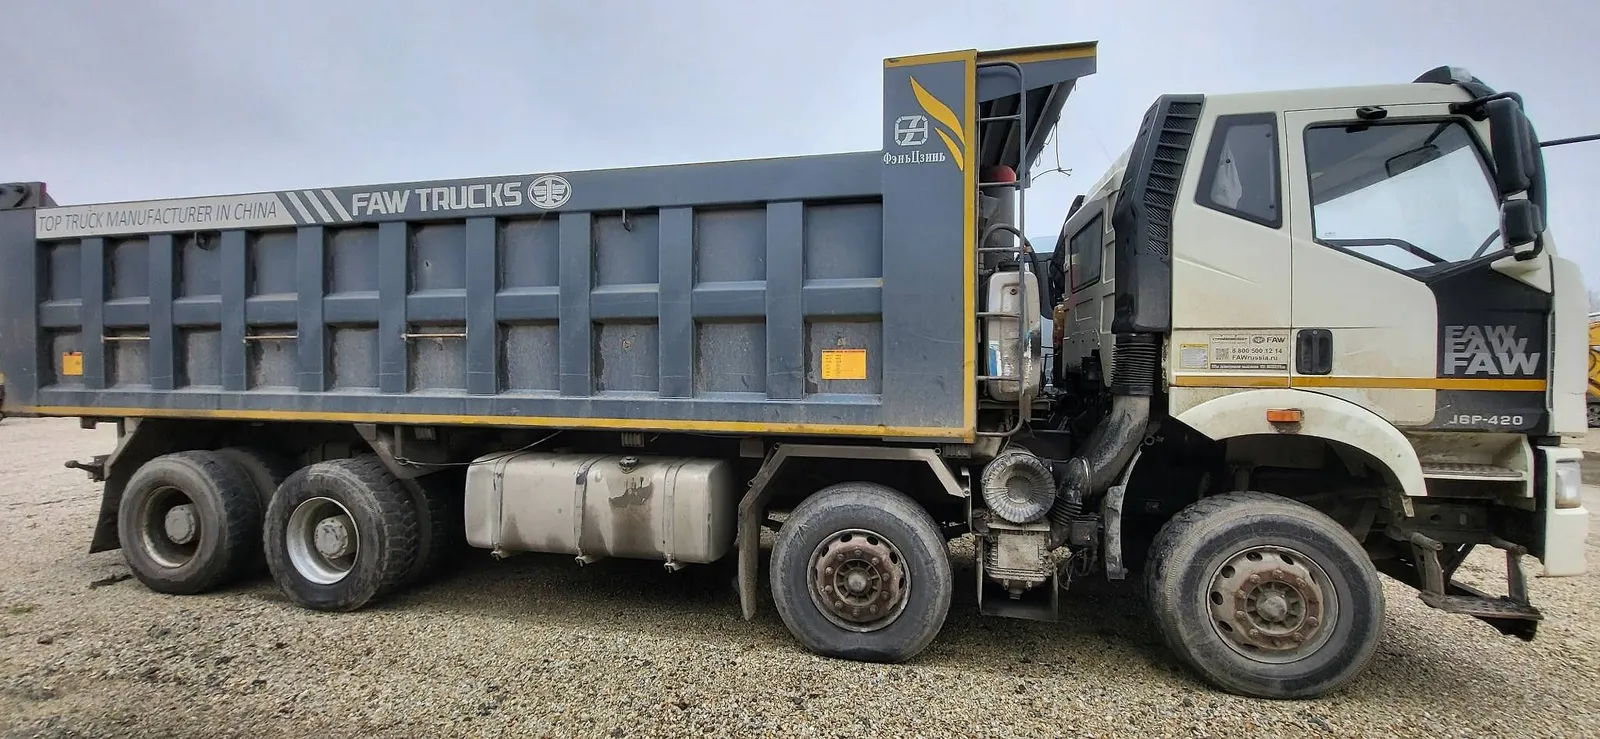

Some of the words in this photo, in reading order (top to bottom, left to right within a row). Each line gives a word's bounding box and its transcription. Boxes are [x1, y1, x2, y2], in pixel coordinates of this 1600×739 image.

[352, 189, 411, 217] FAW
[415, 181, 523, 212] TRUCKS
[39, 215, 63, 232] TOP
[65, 211, 105, 231] TRUCK
[106, 204, 213, 228] MANUFACTURER
[215, 203, 234, 221] IN
[234, 201, 277, 220] CHINA
[1443, 352, 1541, 375] FAW
[1449, 414, 1524, 426] J6P-420
